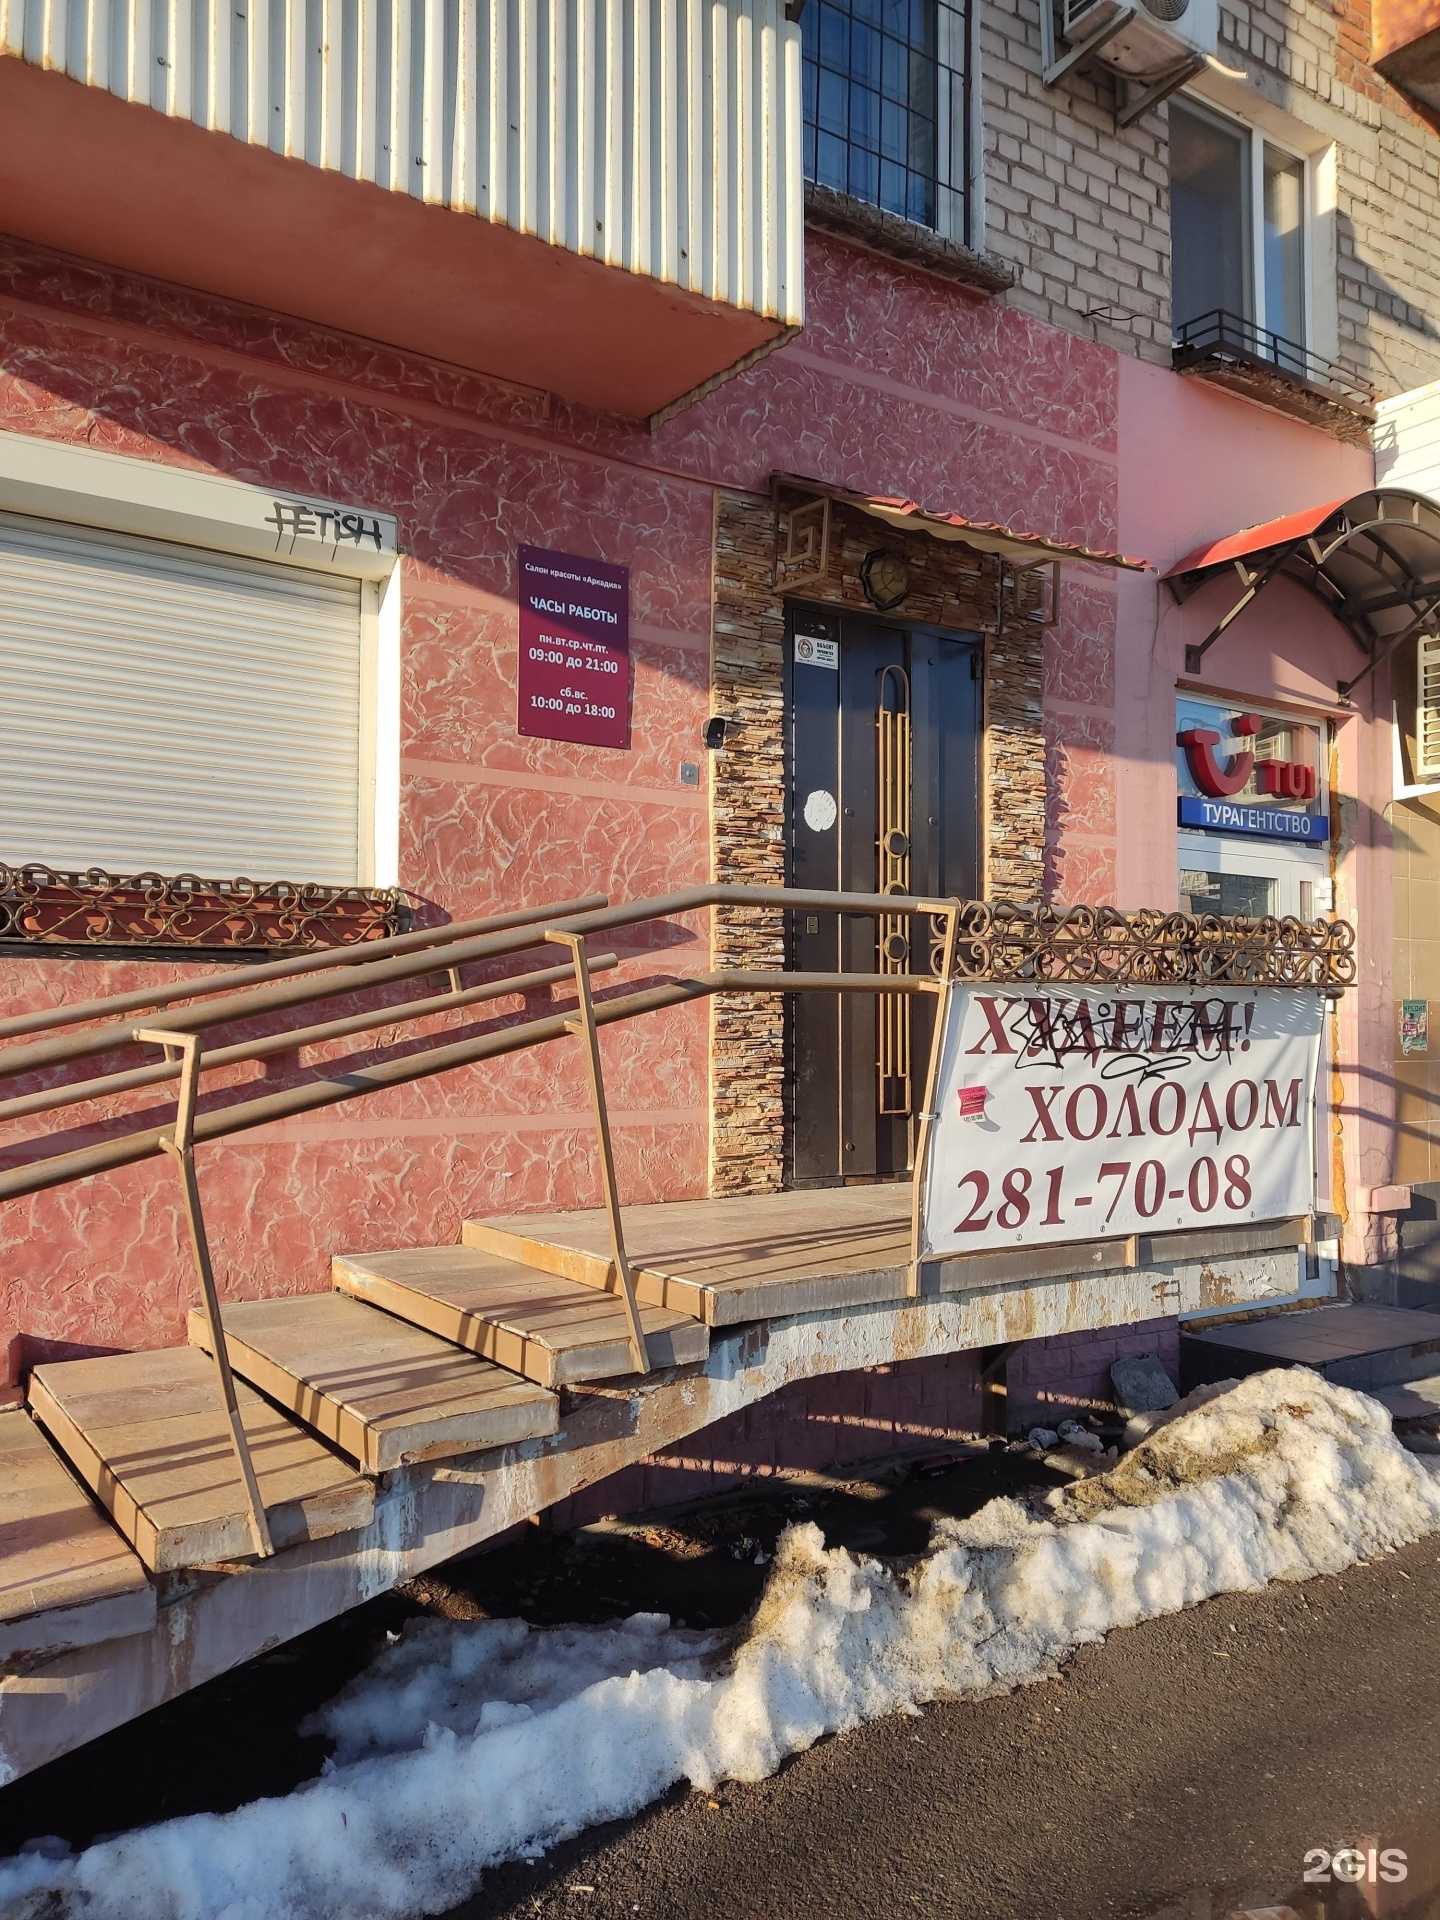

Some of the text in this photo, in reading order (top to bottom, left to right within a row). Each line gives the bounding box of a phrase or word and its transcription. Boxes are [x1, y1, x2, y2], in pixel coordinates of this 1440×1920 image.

[525, 562, 622, 590] Салон красоты «Аркадия»
[530, 596, 618, 625] ЧАСЫ РАБОТЫ
[539, 634, 609, 655] пн.вт.ср.чт.пт.
[528, 647, 618, 674] 09:00 до 21:00
[530, 695, 616, 719] 10:00 до 18:00
[559, 686, 589, 700] сб.вс.
[1203, 803, 1311, 835] ТУРАГЕНТСТВО
[964, 996, 1254, 1067] ХУДЕЕМ!
[1019, 1078, 1304, 1147] ХОЛОДОМ
[954, 1154, 1252, 1234] 281-70-08
